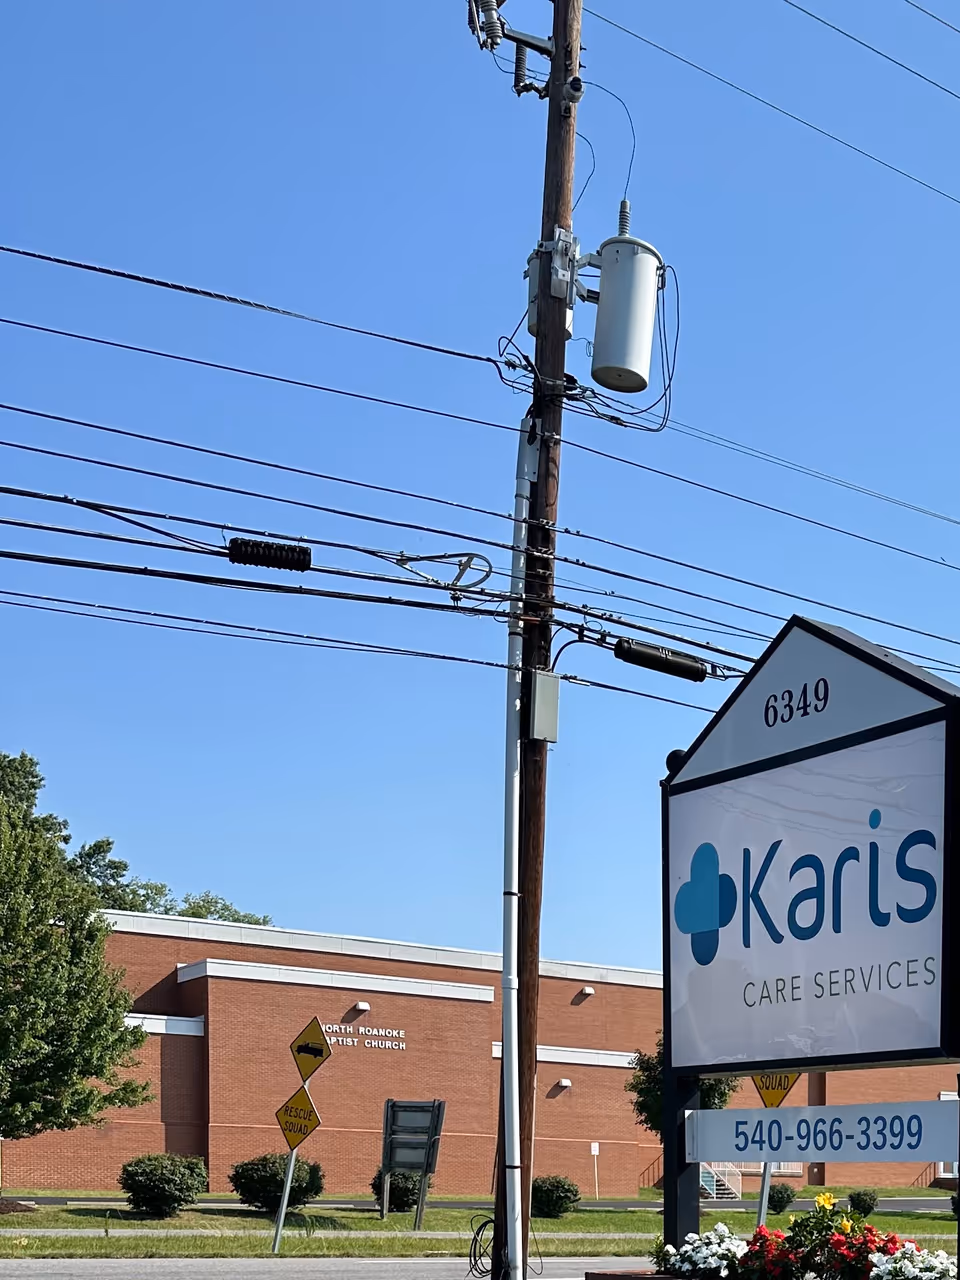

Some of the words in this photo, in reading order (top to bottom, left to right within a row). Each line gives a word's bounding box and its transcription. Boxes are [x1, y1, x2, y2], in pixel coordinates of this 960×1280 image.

[764, 677, 829, 728] 6349
[742, 808, 937, 948] Karis
[743, 975, 802, 1007] CARE
[813, 956, 936, 999] SERVICES
[358, 1026, 405, 1038] ROANOKE
[326, 1036, 358, 1046] APTIST
[364, 1039, 406, 1050] CHURCH
[759, 1074, 790, 1091] SQUAD
[283, 1105, 314, 1122] RESCUE
[283, 1120, 309, 1136] SQUAD
[734, 1114, 923, 1152] 540-966-3399
